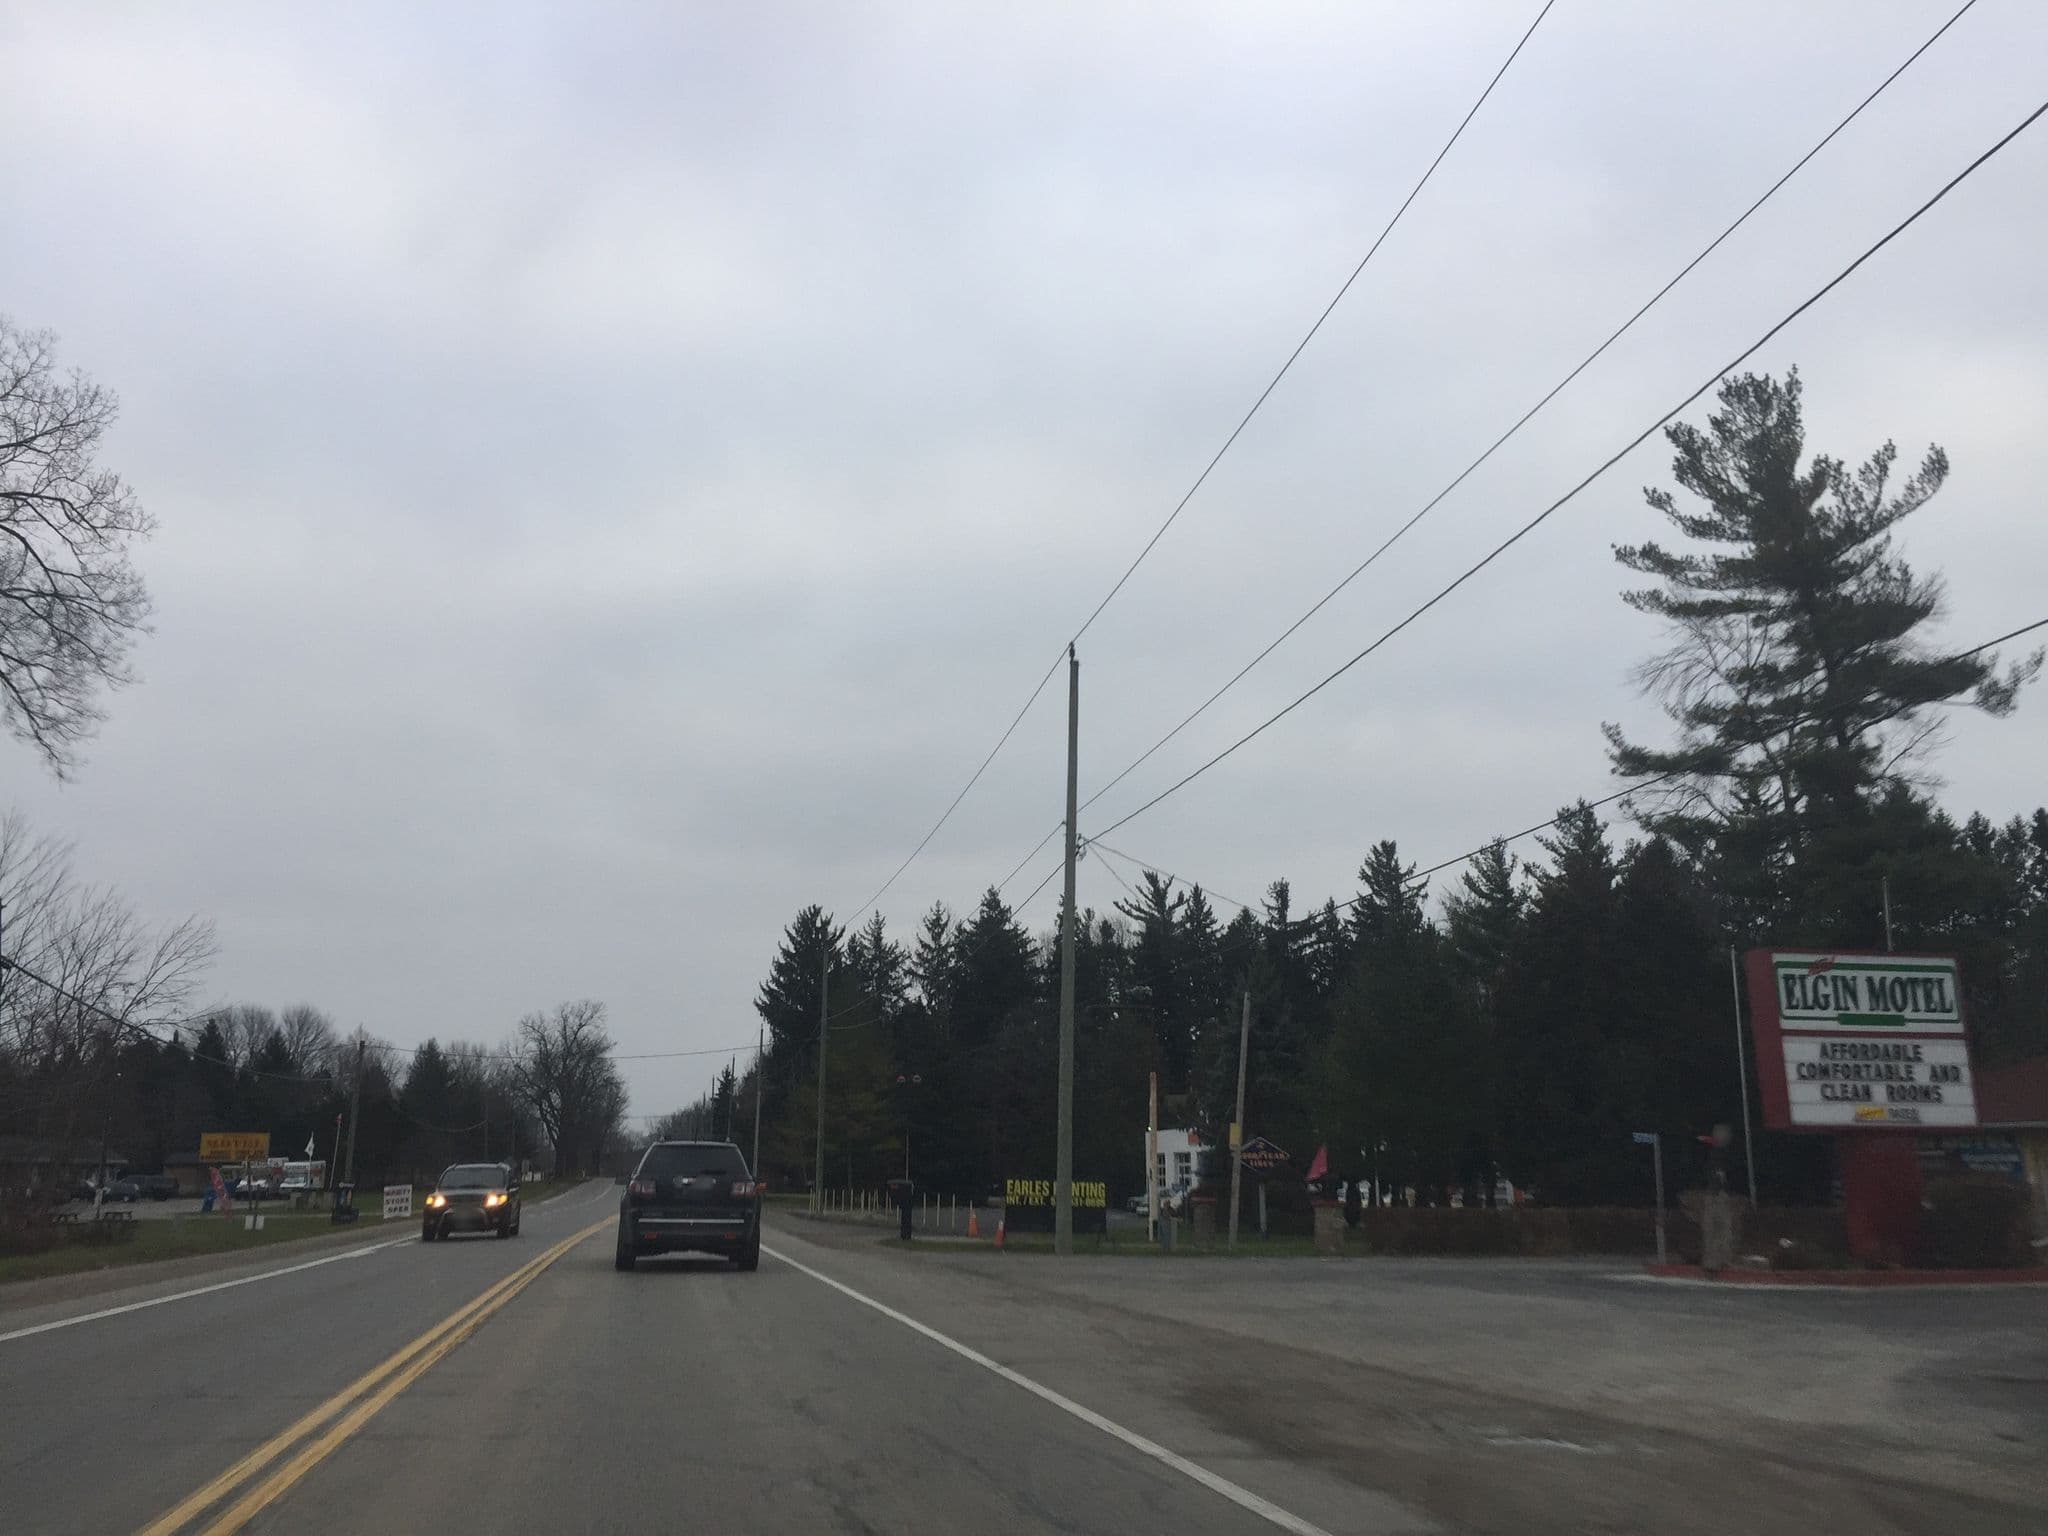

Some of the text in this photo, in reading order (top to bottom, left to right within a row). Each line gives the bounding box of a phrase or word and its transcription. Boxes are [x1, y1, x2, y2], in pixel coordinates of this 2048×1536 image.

[1783, 974, 1953, 1013] ELGIN MOTEL
[1819, 1042, 1922, 1061] AFFORDABLE
[1796, 1062, 1961, 1083] COMFORTABLE AND
[1820, 1083, 1943, 1103] CLEAN ROOMS
[1006, 1179, 1106, 1200] EARLES NTING
